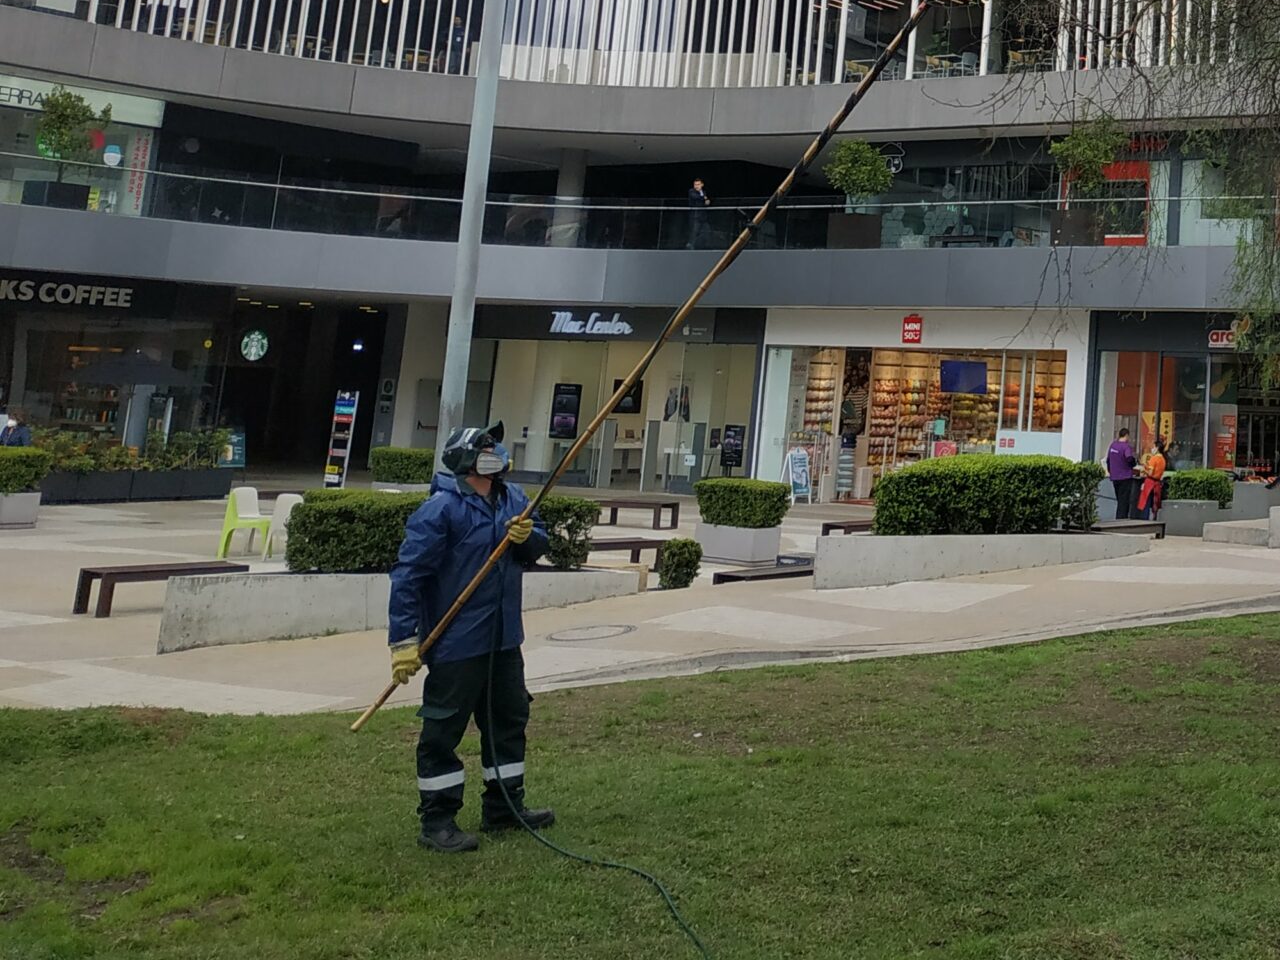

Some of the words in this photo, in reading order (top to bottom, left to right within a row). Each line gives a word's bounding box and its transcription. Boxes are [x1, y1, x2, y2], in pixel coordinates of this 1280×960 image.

[0, 280, 36, 300] KS
[39, 283, 133, 307] COFFEE
[549, 311, 586, 334] Mac
[585, 311, 634, 335] Center
[904, 322, 920, 330] MINI
